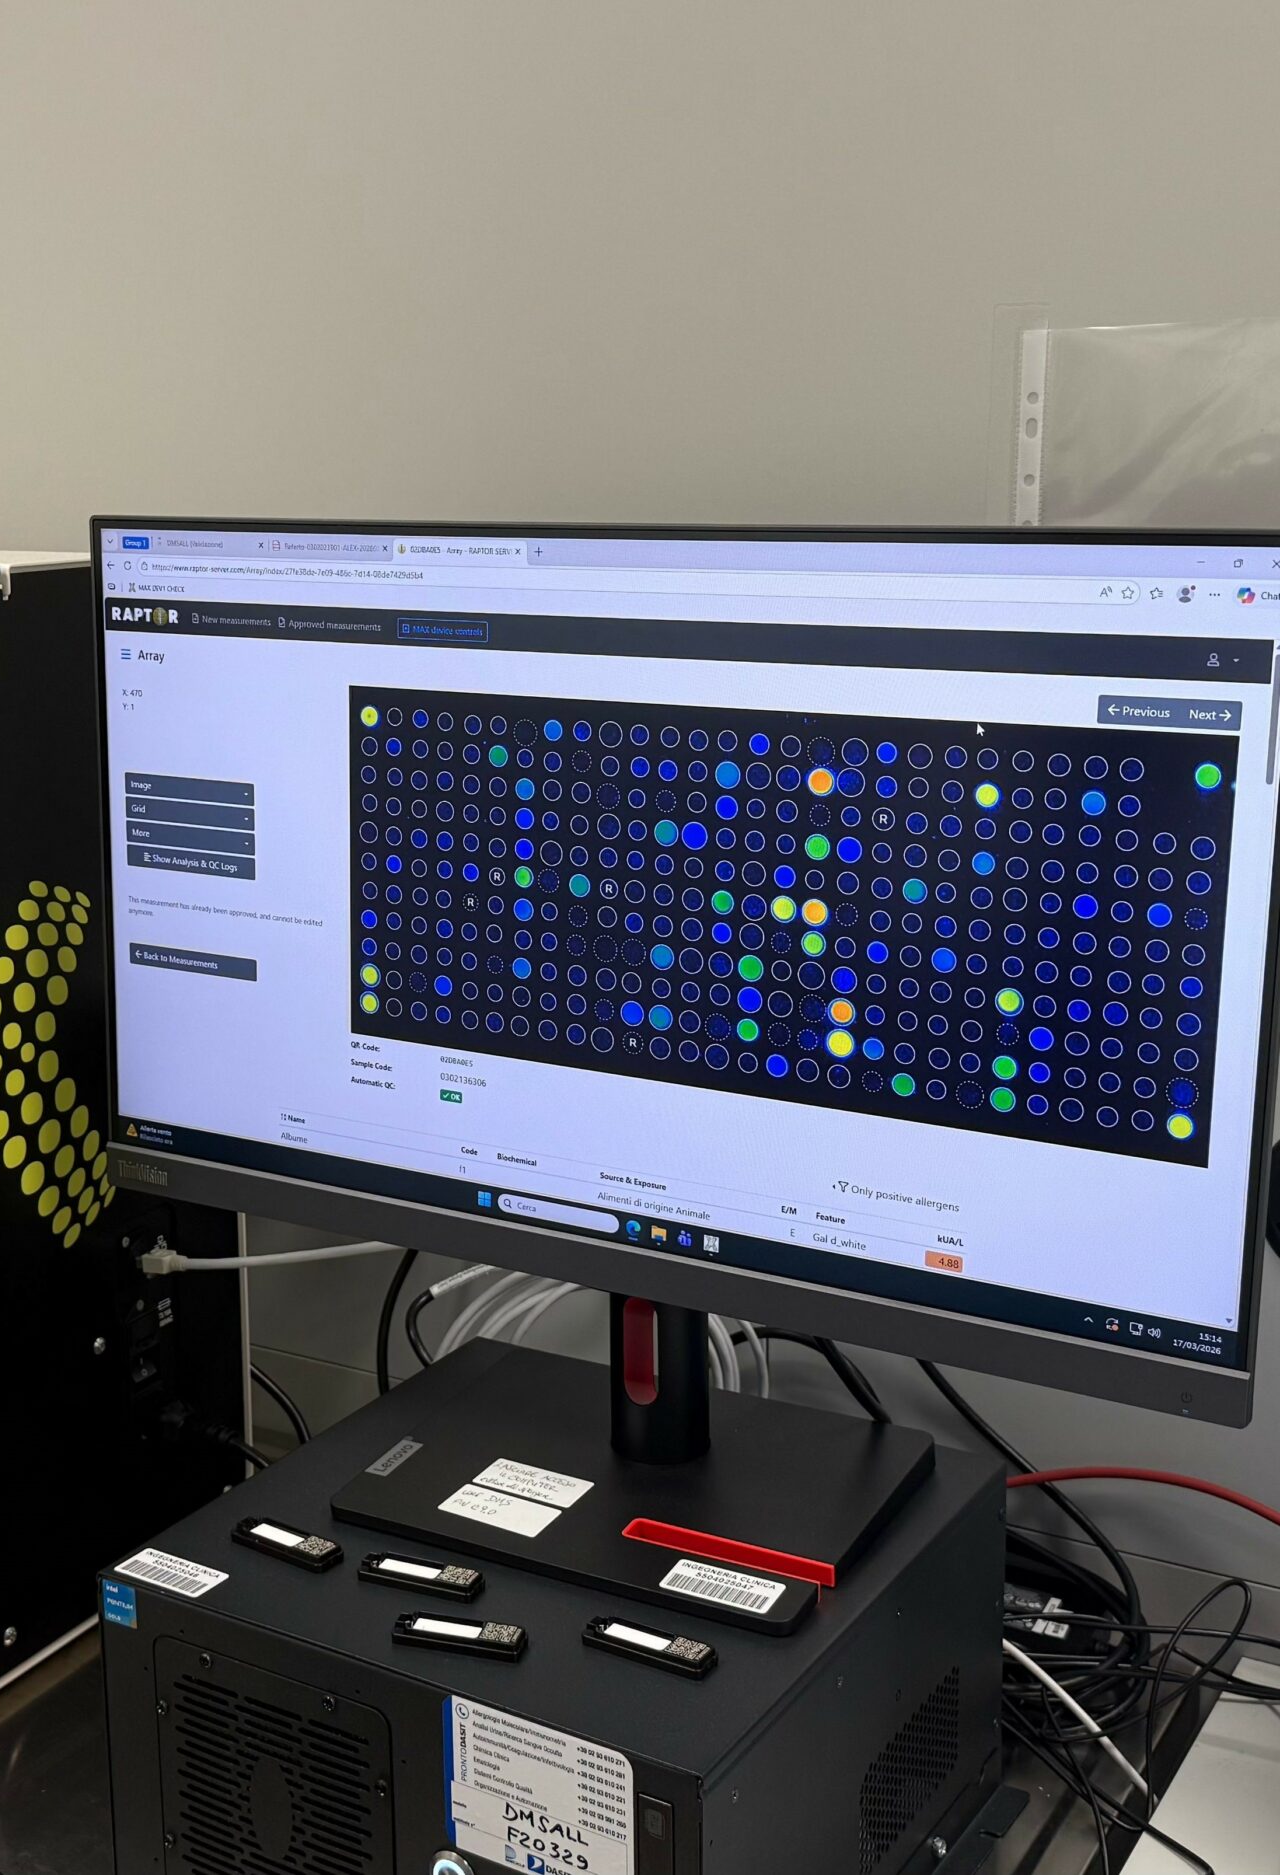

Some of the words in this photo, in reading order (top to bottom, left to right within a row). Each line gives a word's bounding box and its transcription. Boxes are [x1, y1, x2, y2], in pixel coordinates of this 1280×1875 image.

[111, 607, 178, 626] RAPTOR
[202, 616, 218, 624] New
[220, 617, 271, 626] measurements
[289, 619, 323, 630] Approved
[326, 622, 381, 632] measurements
[138, 650, 165, 664] Array
[130, 689, 142, 697] 470
[1122, 706, 1170, 718] Previous
[1189, 709, 1216, 720] Next
[131, 781, 152, 791] Image
[132, 805, 146, 813] Grid
[880, 814, 887, 824] R
[132, 829, 150, 837] More
[153, 854, 171, 863] Show
[172, 857, 199, 868] Analysis
[209, 861, 219, 870] QC
[221, 863, 238, 873] Logs
[493, 872, 500, 881] R
[605, 884, 613, 893] R
[467, 898, 474, 906] R
[192, 904, 211, 914] already
[213, 907, 228, 915] been
[144, 952, 159, 961] Back
[169, 956, 218, 969] Measurements
[350, 1041, 360, 1049] QR
[362, 1043, 380, 1052] Code:
[629, 1038, 637, 1047] R
[351, 1059, 373, 1069] Sample
[375, 1062, 392, 1072] Code:
[351, 1077, 383, 1088] Automatic
[384, 1082, 396, 1090] QC:
[440, 1072, 486, 1087] 0302136306
[287, 1115, 306, 1124] Name
[461, 1146, 478, 1155] Code
[497, 1153, 537, 1166] Biochemical
[118, 1160, 168, 1187] ThinkVision
[600, 1172, 624, 1183] Source
[634, 1178, 666, 1190] Exposure
[851, 1185, 873, 1199] Only
[876, 1190, 913, 1204] positive
[915, 1196, 960, 1212] allergens
[517, 1202, 536, 1212] Cerca
[598, 1192, 631, 1205] Alimenti
[634, 1198, 641, 1207] di
[644, 1201, 674, 1213] origine
[676, 1207, 711, 1220] Animale
[781, 1206, 797, 1216] E/M
[816, 1212, 846, 1225] Feature
[790, 1229, 796, 1237] E
[813, 1233, 828, 1244] Gal
[831, 1236, 867, 1250] d_white
[937, 1234, 964, 1247] kUA/L
[938, 1257, 959, 1269] 4.88
[1200, 1333, 1222, 1343] 15:14
[1173, 1339, 1221, 1354] 17/03/2026
[373, 1445, 413, 1472] Lenovo
[682, 1562, 737, 1580] INGEGNERIA
[740, 1576, 776, 1590] CLINICA
[695, 1572, 754, 1590] 5504025047
[502, 1802, 589, 1846] DMSALL
[507, 1826, 589, 1870] F20329
